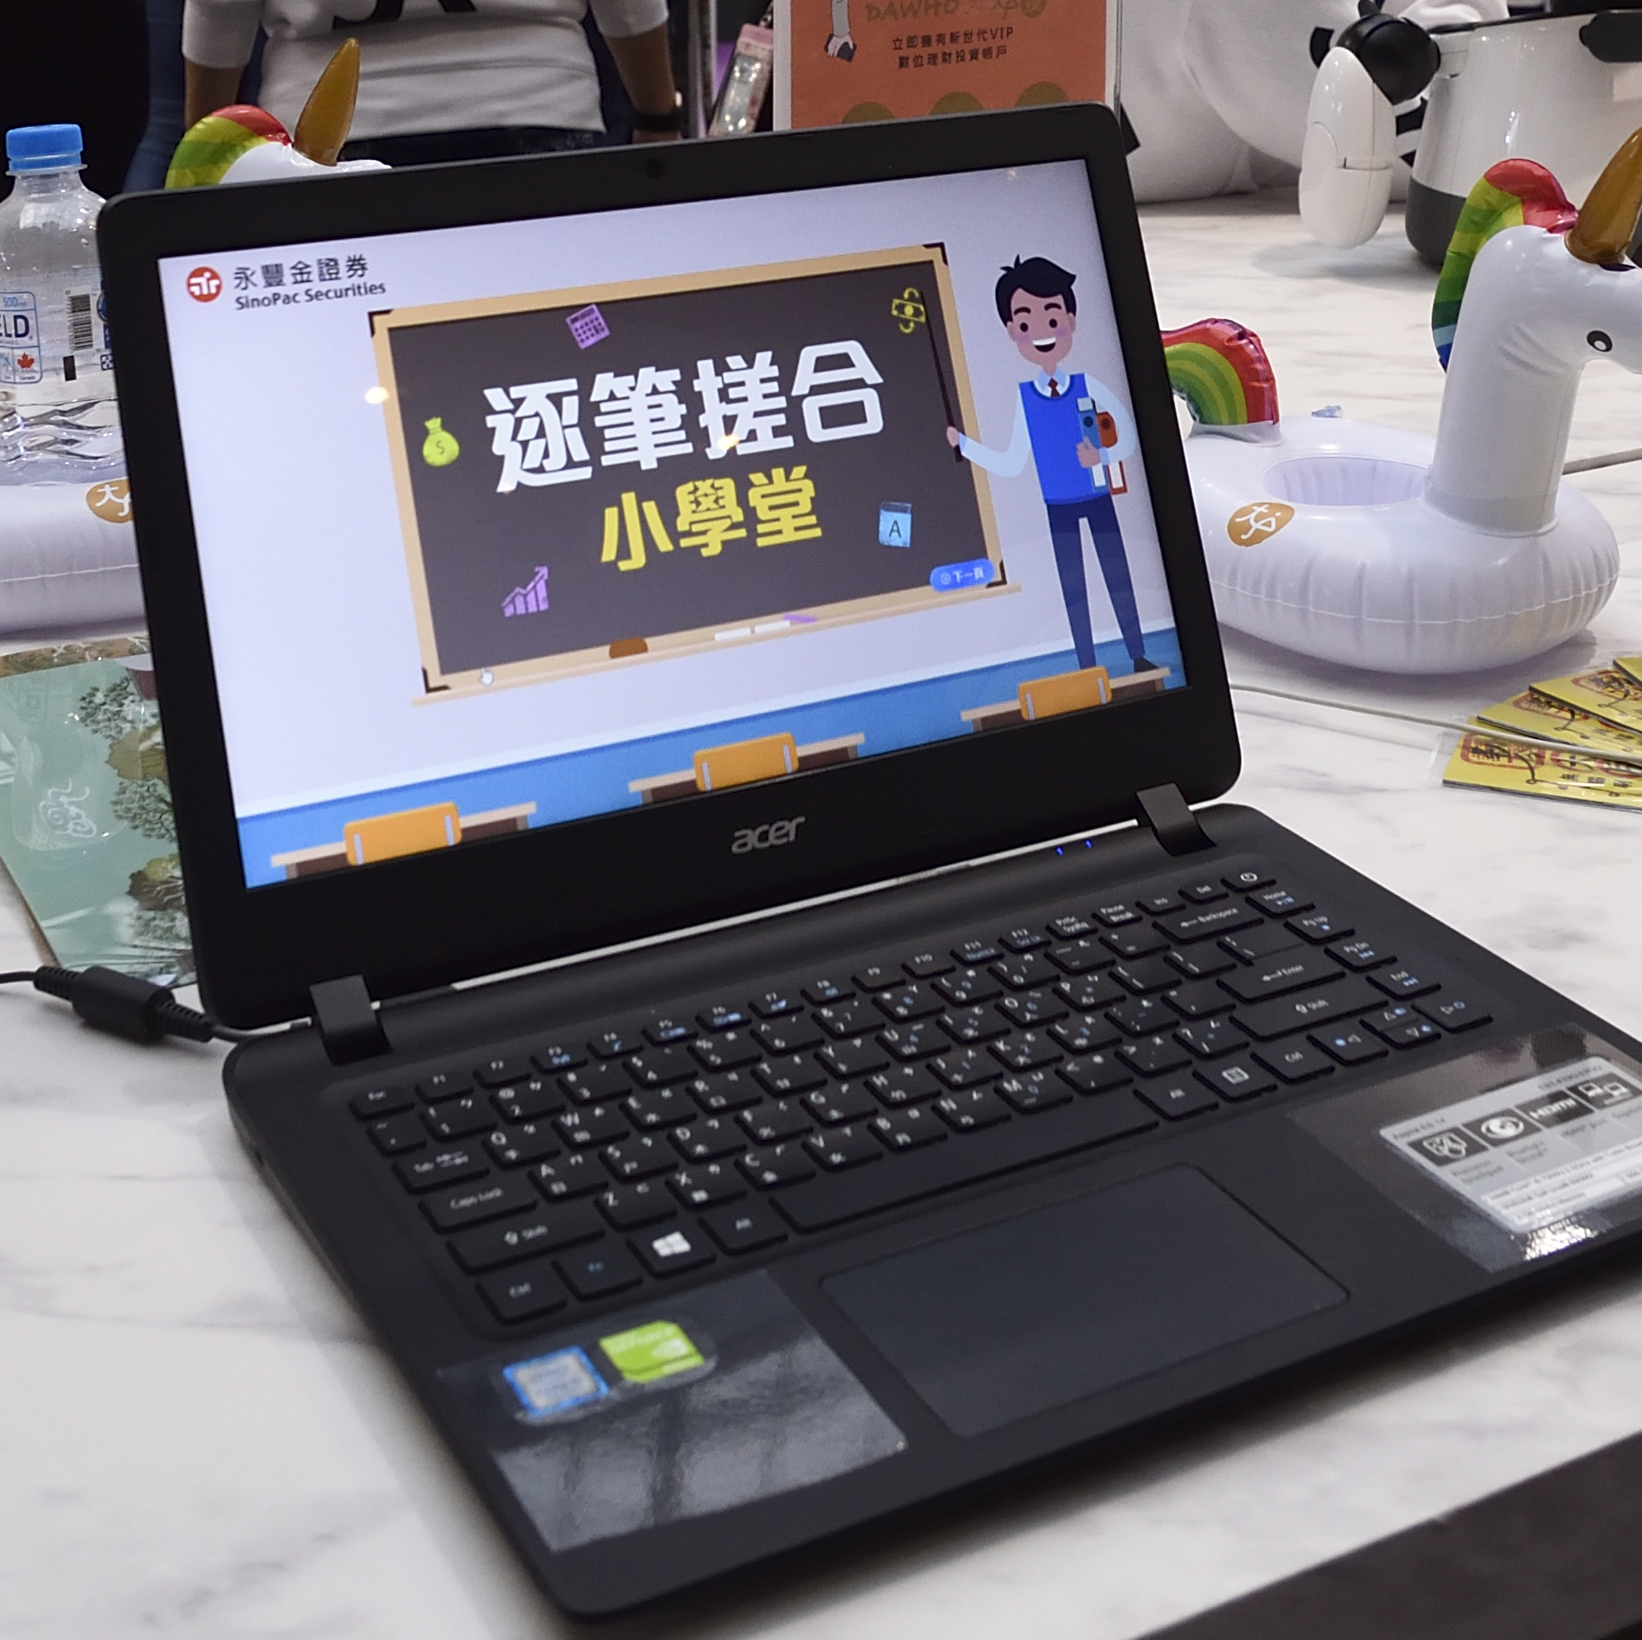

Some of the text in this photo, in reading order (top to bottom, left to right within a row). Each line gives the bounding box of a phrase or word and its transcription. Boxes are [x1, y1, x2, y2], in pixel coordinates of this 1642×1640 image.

[892, 26, 1015, 51] 立即擁有新世代VIP
[897, 45, 1008, 70] 數位理財投資帳戶
[233, 253, 369, 291] 永豐金證券
[235, 280, 387, 310] SinoPac Securities
[483, 339, 885, 494] 逐筆搓合
[599, 464, 823, 571] 小學堂
[730, 816, 807, 854] acer
[1529, 1098, 1576, 1121] HDMI
